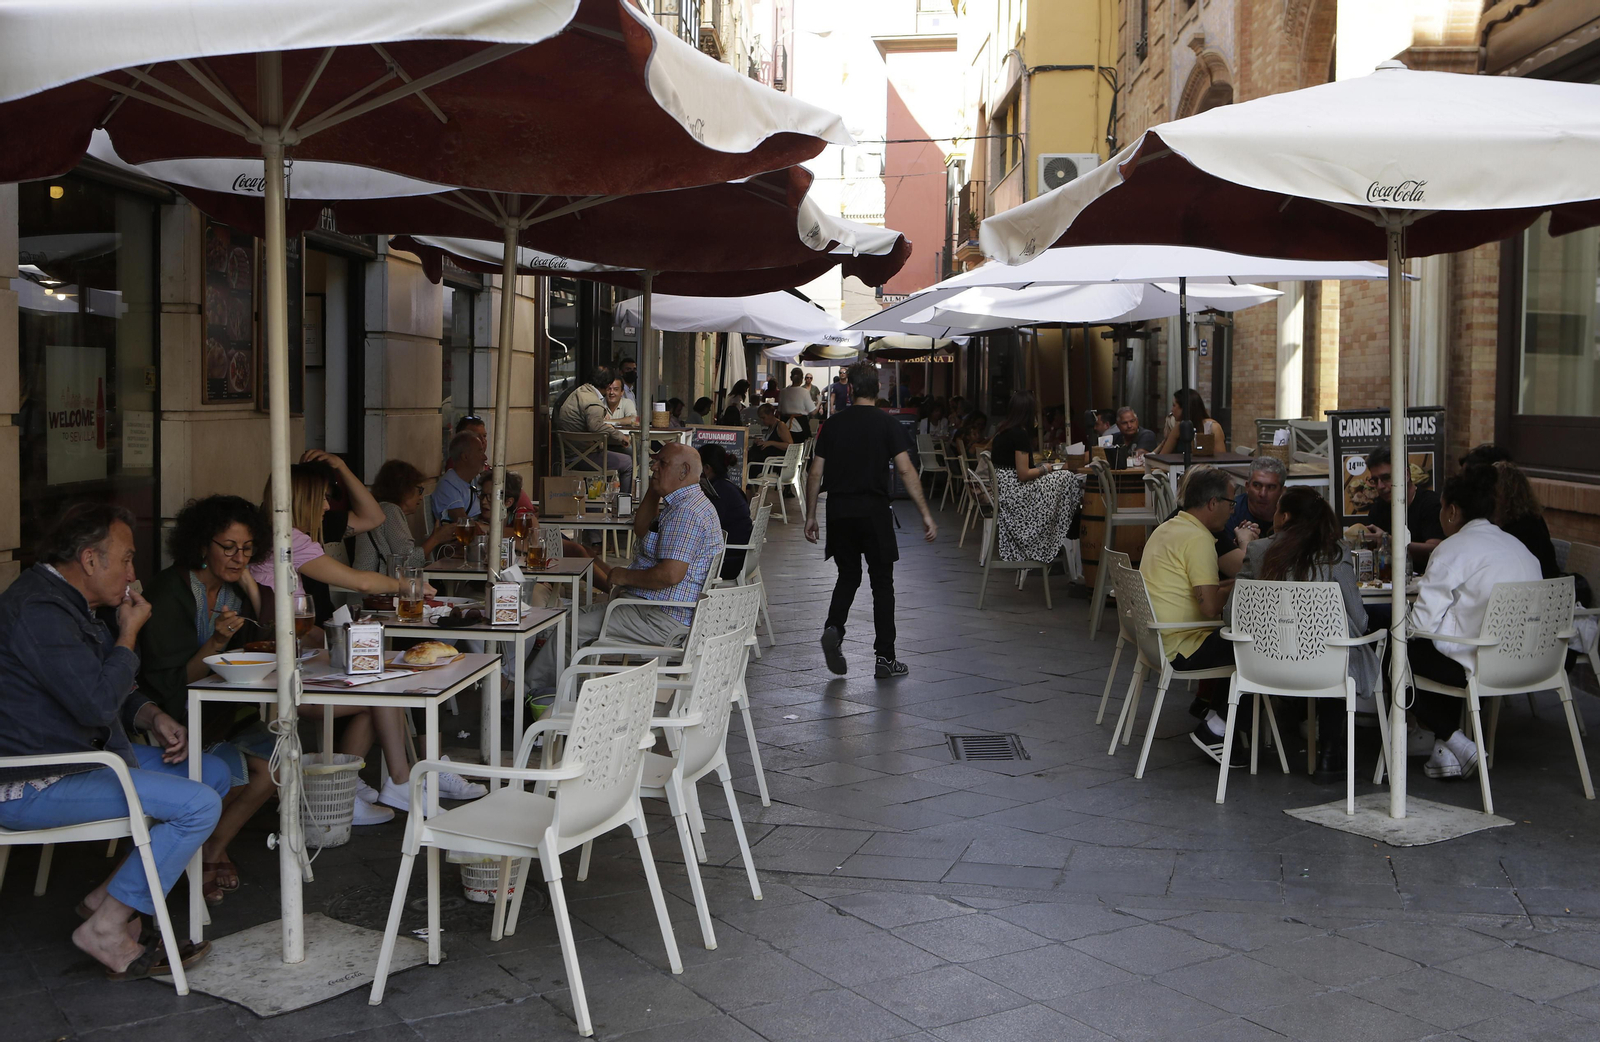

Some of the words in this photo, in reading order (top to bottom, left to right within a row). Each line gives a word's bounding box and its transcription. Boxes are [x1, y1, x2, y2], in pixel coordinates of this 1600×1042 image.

[1366, 180, 1428, 203] Coca-Cola
[530, 256, 569, 269] Coca-Cola
[49, 408, 95, 429] WELCOME
[1339, 418, 1381, 437] CARNES
[1384, 416, 1436, 436] IRICAS
[62, 432, 69, 440] TO
